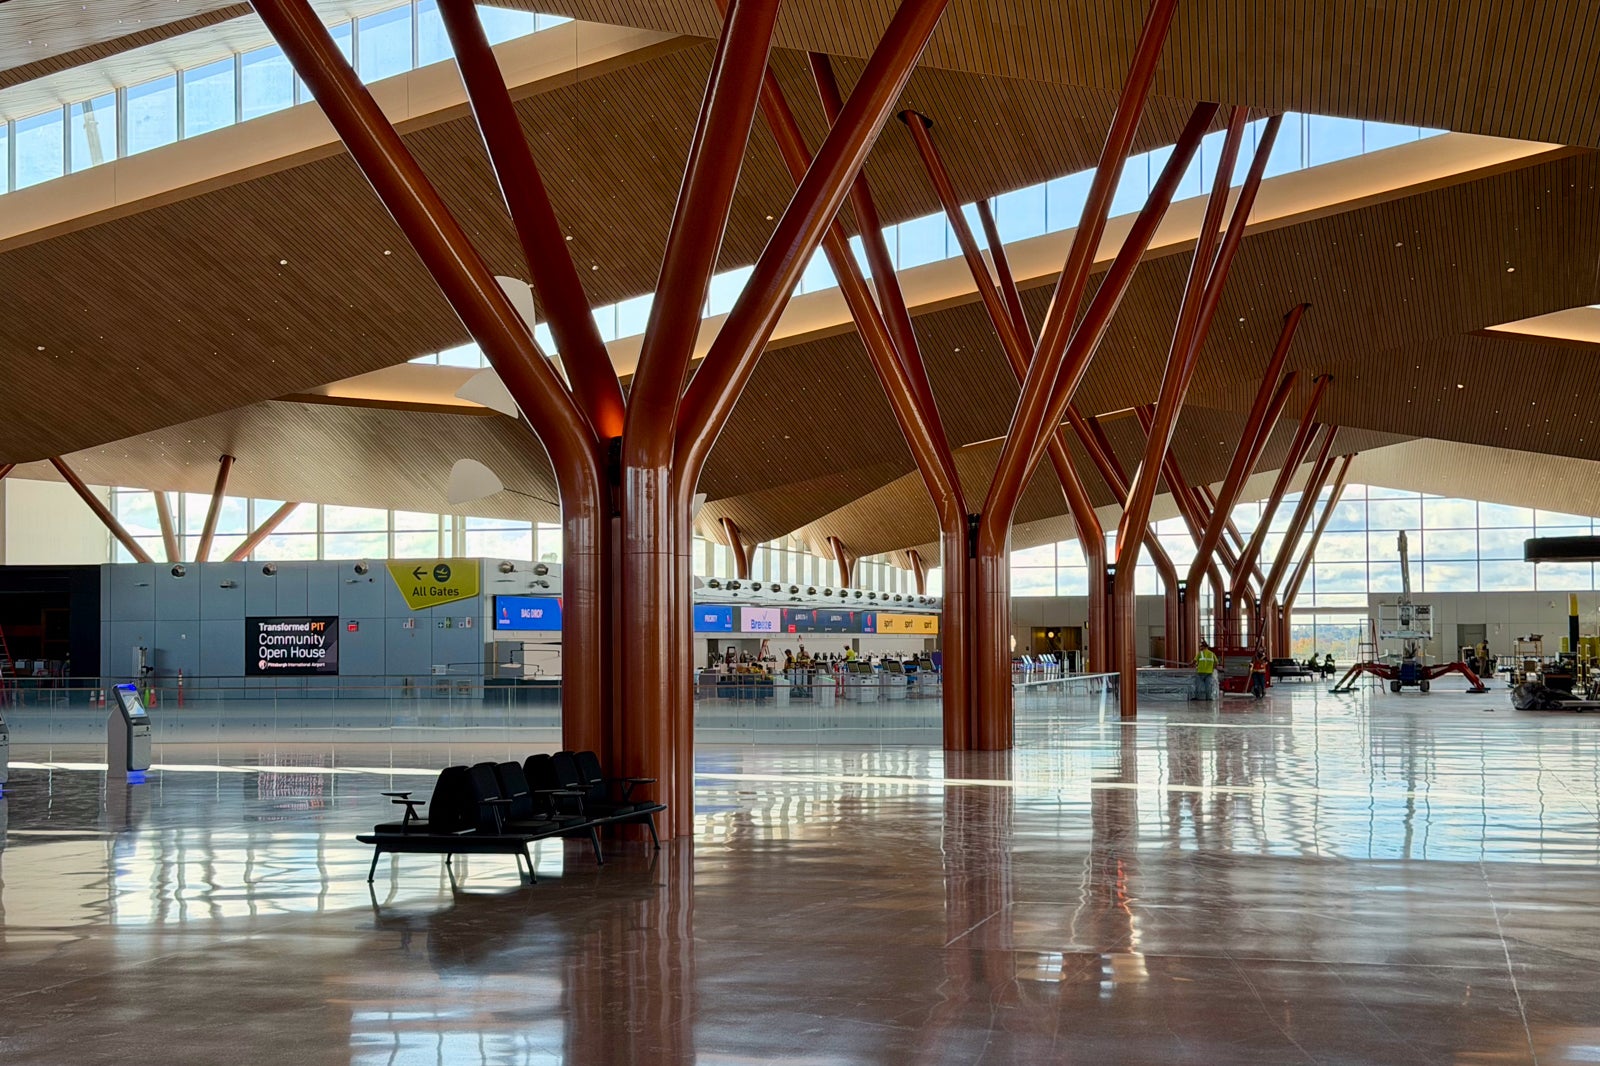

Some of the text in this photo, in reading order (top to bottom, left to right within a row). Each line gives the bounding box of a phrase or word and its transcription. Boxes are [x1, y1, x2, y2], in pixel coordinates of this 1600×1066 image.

[412, 586, 460, 597] All Gates
[258, 622, 325, 631] Transformed PIT
[258, 633, 325, 647] Community
[258, 646, 326, 660] Open House
